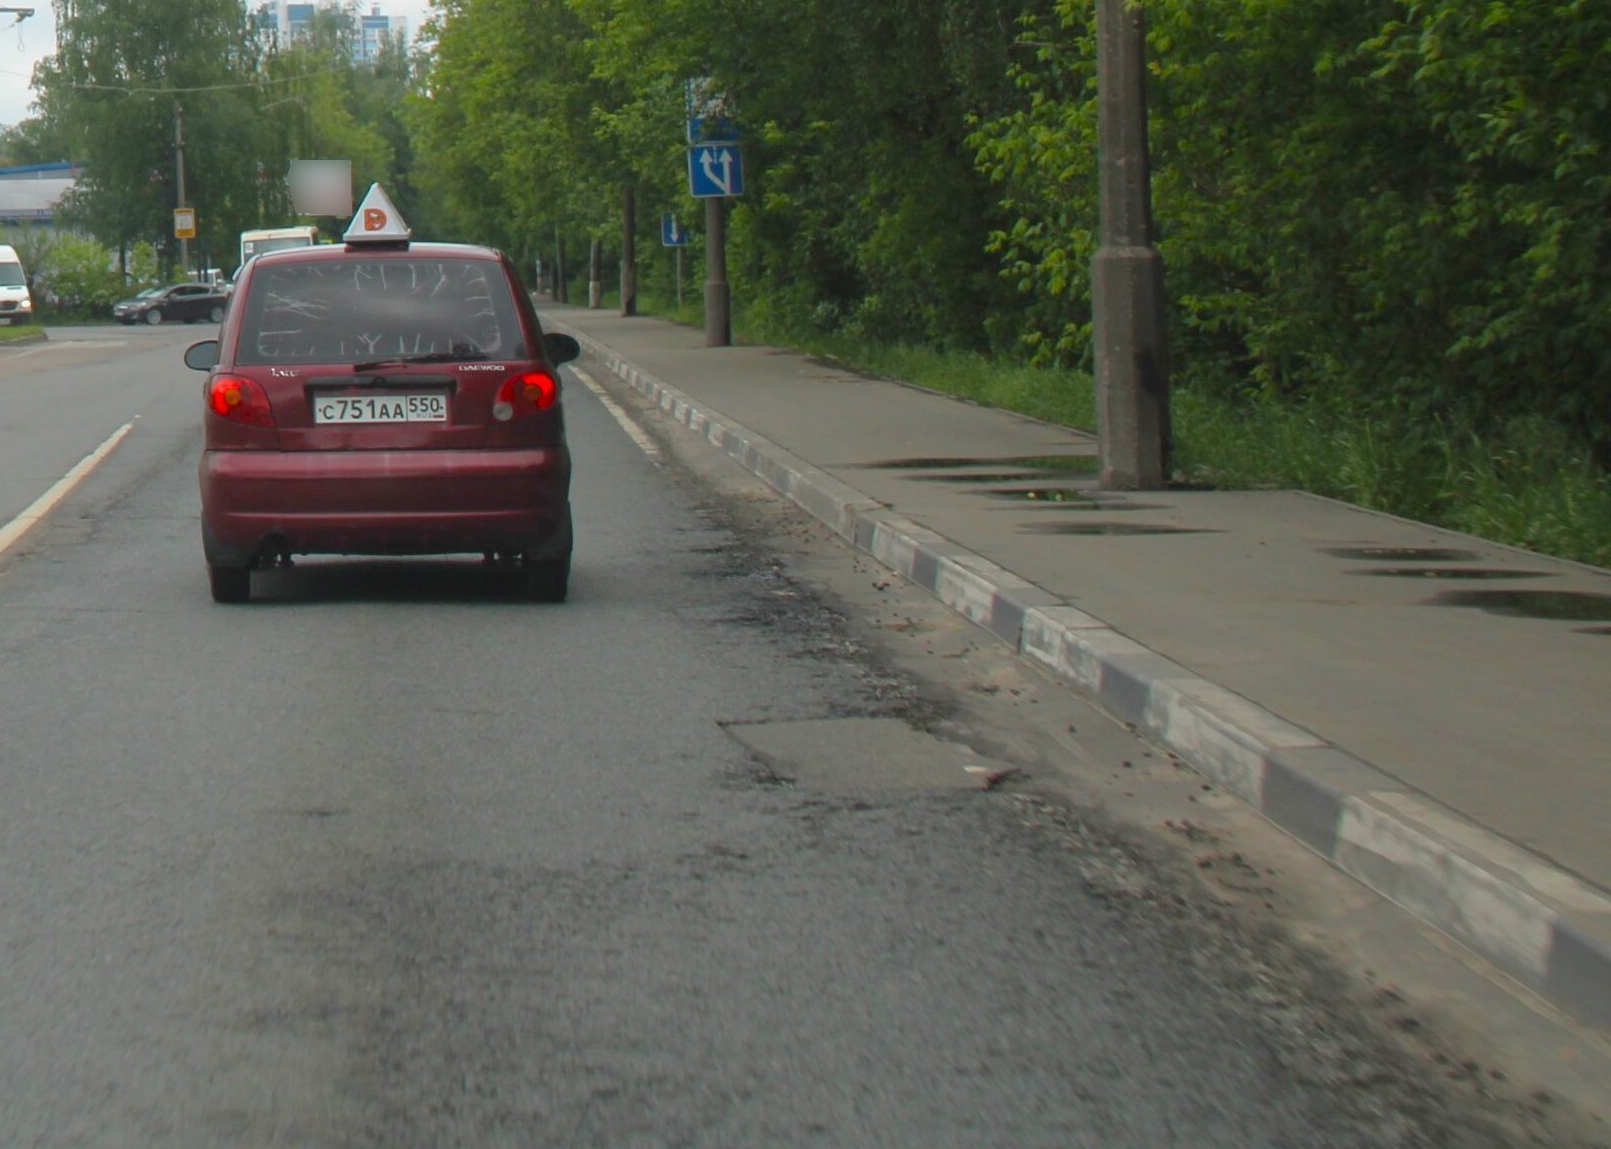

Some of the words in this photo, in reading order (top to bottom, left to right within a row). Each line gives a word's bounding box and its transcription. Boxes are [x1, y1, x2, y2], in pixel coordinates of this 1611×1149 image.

[459, 364, 505, 372] DAEWOO
[323, 399, 406, 420] С751АА
[410, 397, 441, 413] 550
